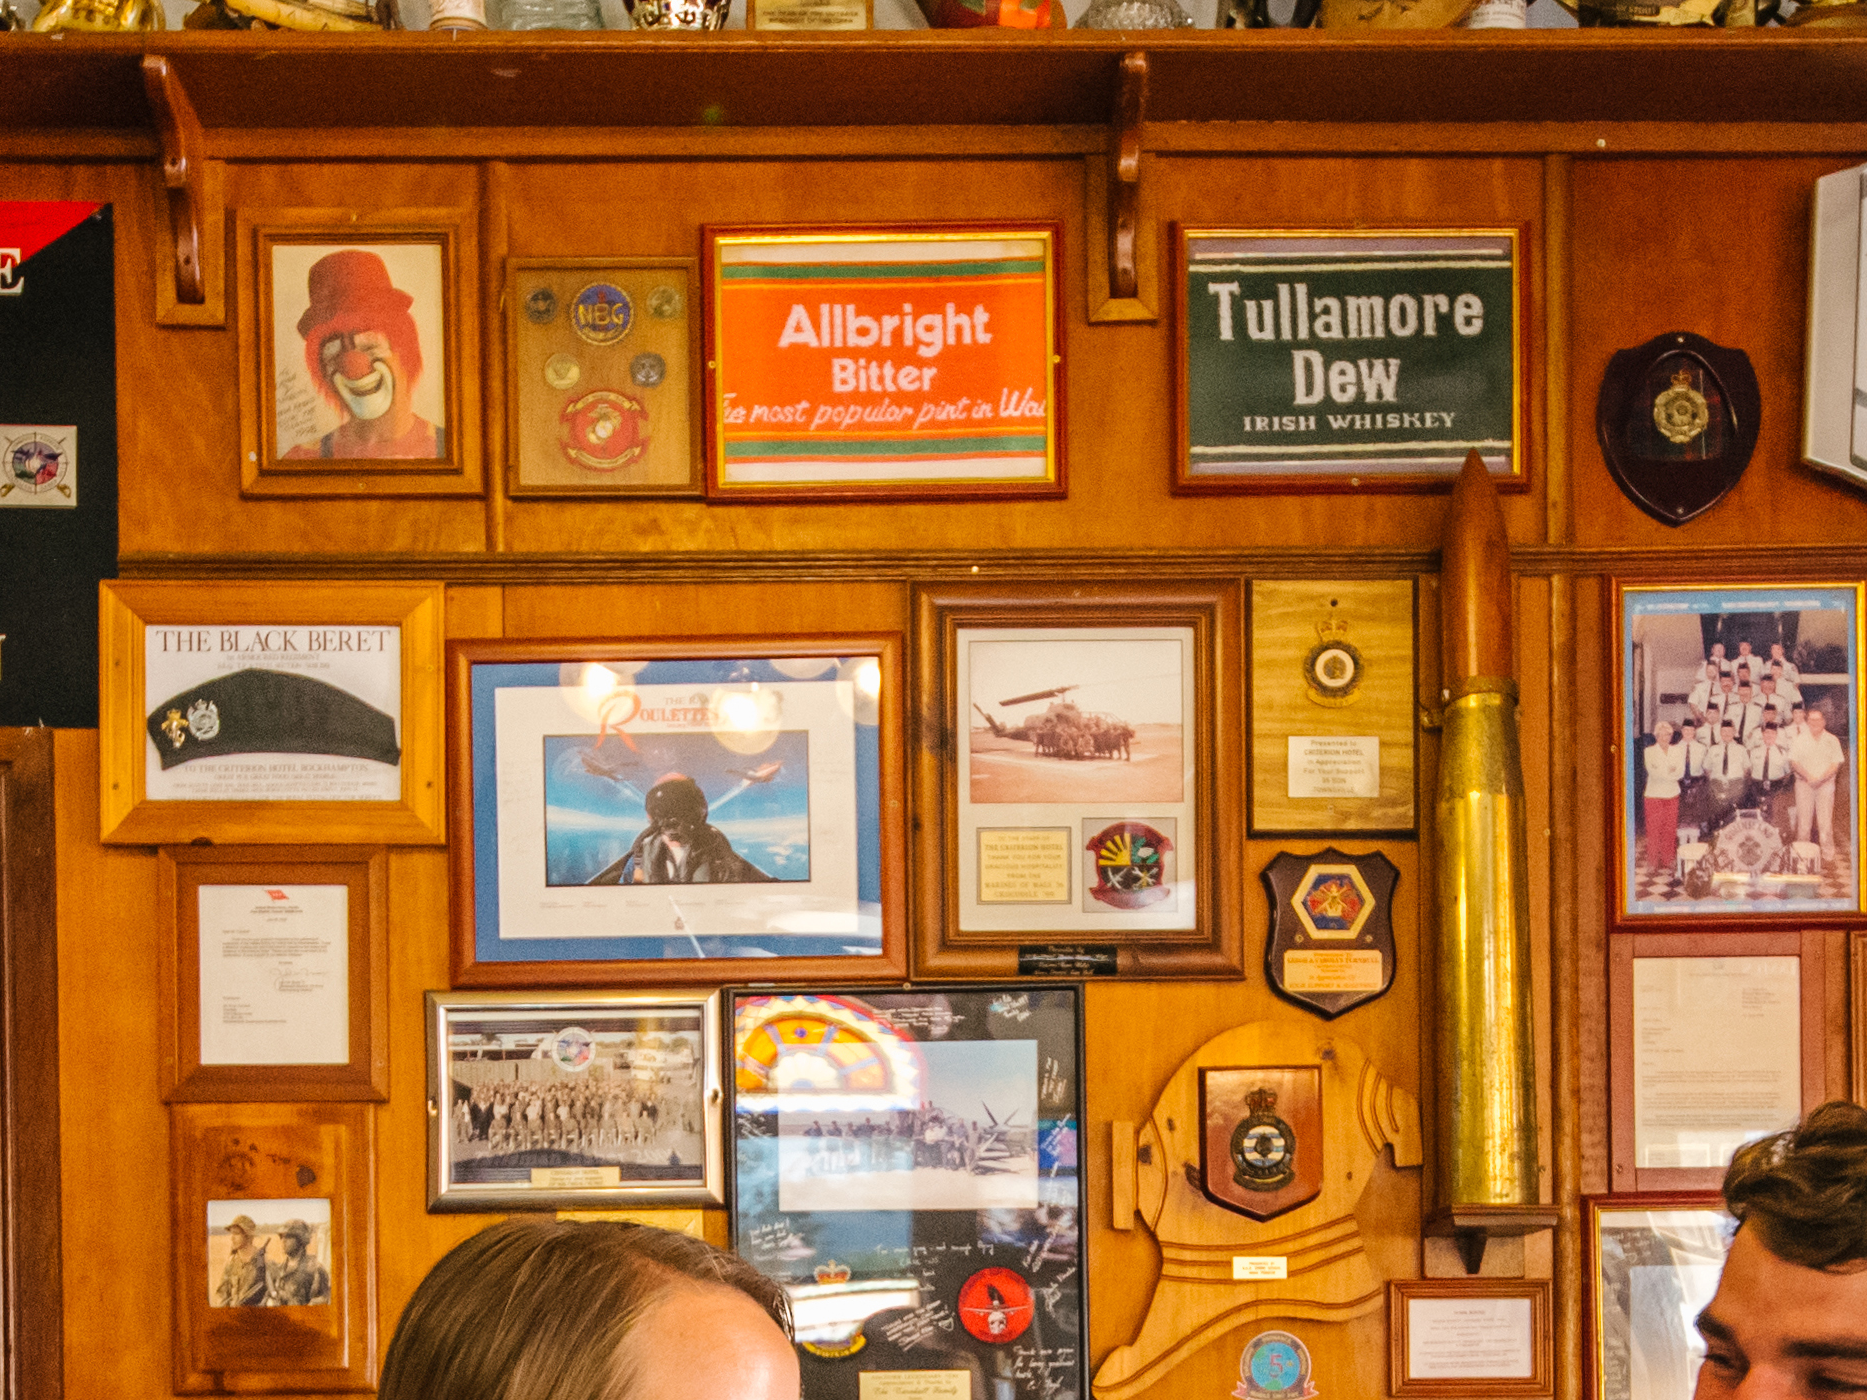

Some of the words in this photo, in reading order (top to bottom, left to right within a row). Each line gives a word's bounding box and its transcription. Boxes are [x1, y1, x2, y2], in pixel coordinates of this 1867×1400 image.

[1208, 282, 1484, 340] Tullamore
[778, 302, 993, 357] Allbright
[832, 358, 937, 392] Bitter
[1291, 350, 1401, 406] Dew
[750, 401, 810, 423] most
[810, 398, 913, 431] popular
[913, 396, 970, 429] pint
[972, 401, 993, 418] in
[1244, 416, 1317, 432] IRISH
[1326, 412, 1456, 430] WHISKEY
[156, 630, 211, 651] THE
[220, 630, 298, 651] BLACK
[308, 630, 390, 651] BERET
